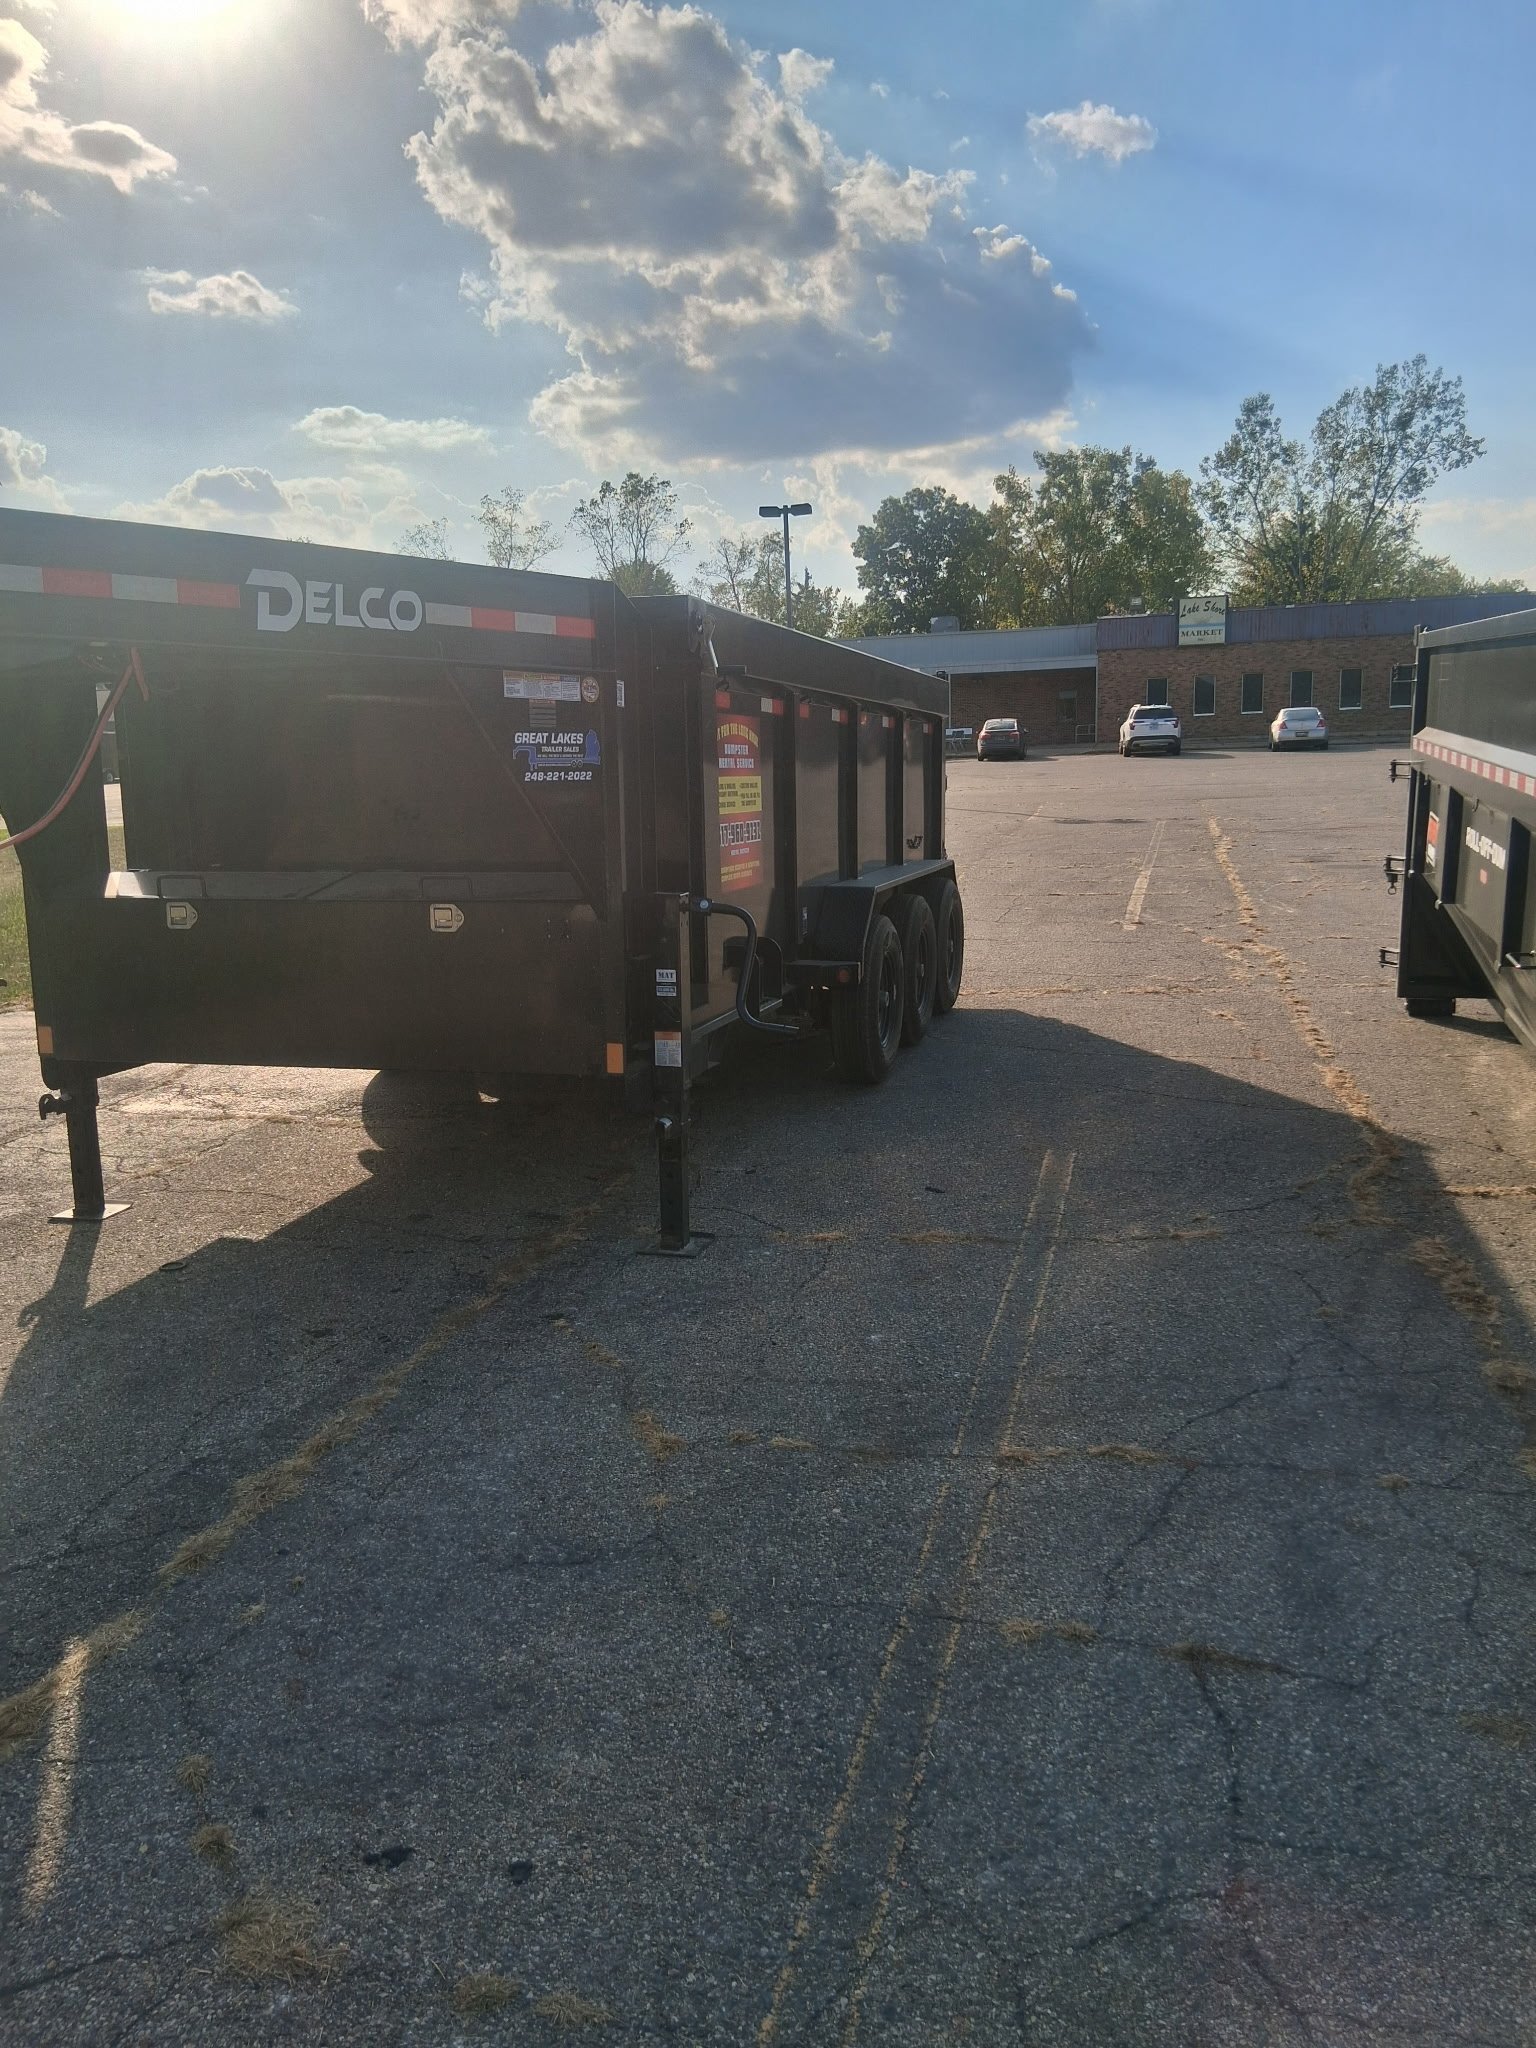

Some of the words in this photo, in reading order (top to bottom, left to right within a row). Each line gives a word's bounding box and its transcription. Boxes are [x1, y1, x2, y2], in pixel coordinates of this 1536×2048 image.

[245, 568, 423, 632] DELCO
[1180, 602, 1200, 618] Lake
[1203, 600, 1225, 616] Shore
[1180, 629, 1224, 637] MARKET
[514, 732, 549, 744] GREAT
[551, 732, 584, 744] LAKES
[724, 743, 749, 755] DUMPSTER
[736, 758, 754, 769] SERVICE
[524, 771, 593, 782] 248-221-2022
